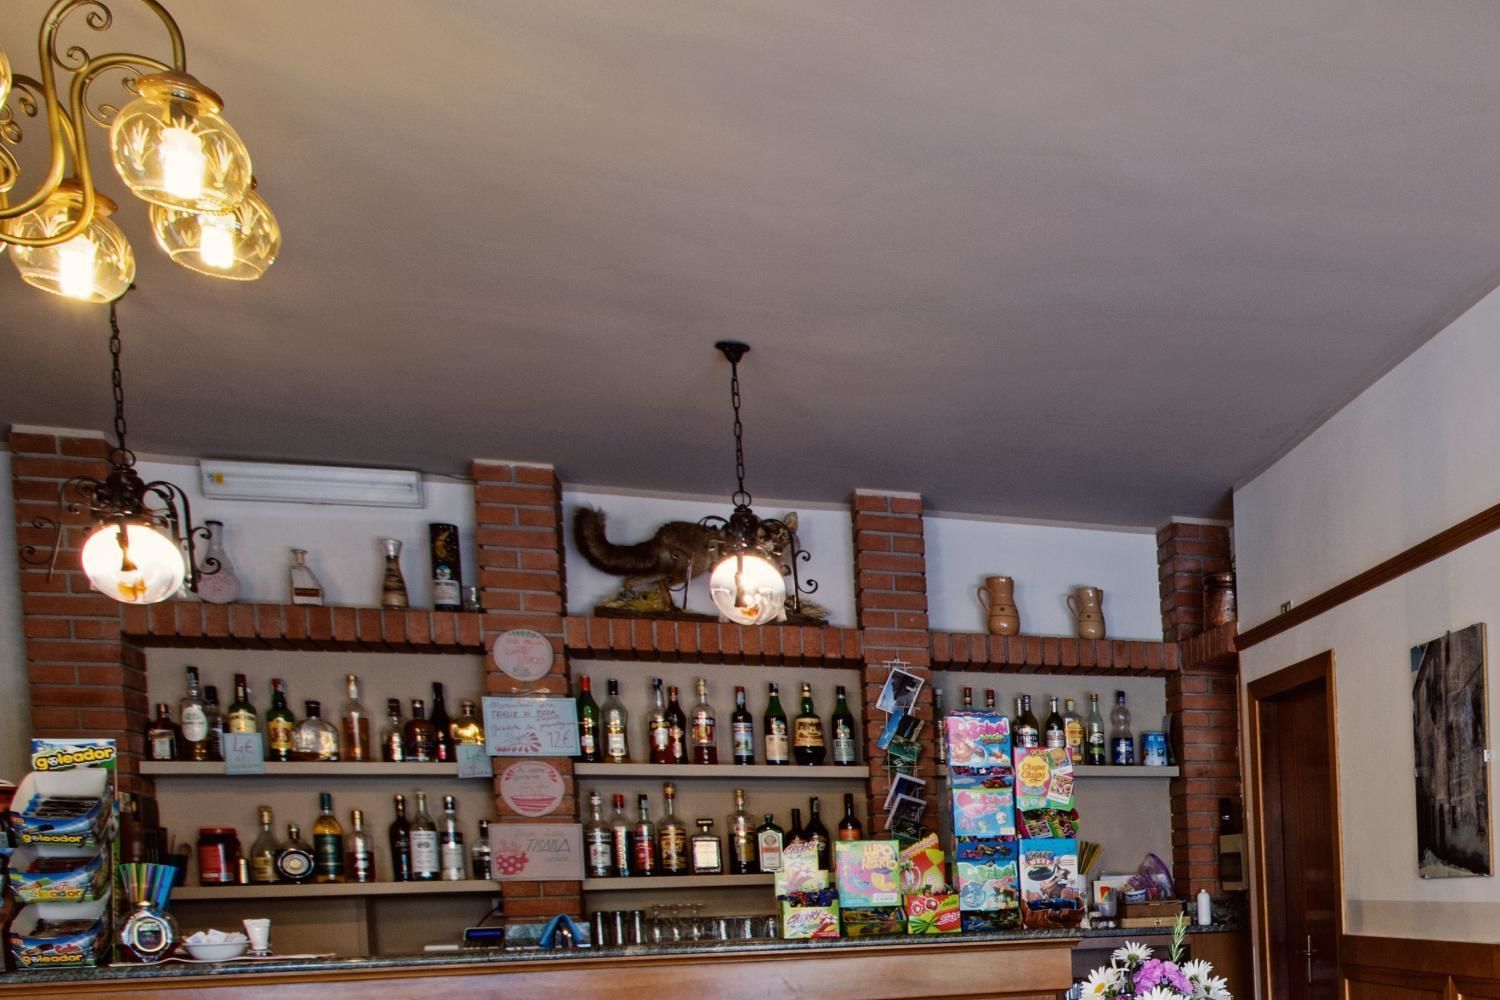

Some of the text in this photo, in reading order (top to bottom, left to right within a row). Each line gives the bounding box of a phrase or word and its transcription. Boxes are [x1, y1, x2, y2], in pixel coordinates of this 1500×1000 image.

[35, 747, 114, 771] goleador
[1021, 762, 1046, 773] Chupa
[1021, 771, 1046, 780] Chups
[21, 833, 84, 844] goleador
[863, 843, 894, 857] LUPO
[861, 855, 898, 870] ALBERTO
[786, 910, 822, 925] CHERRY
[21, 952, 83, 965] goleador
